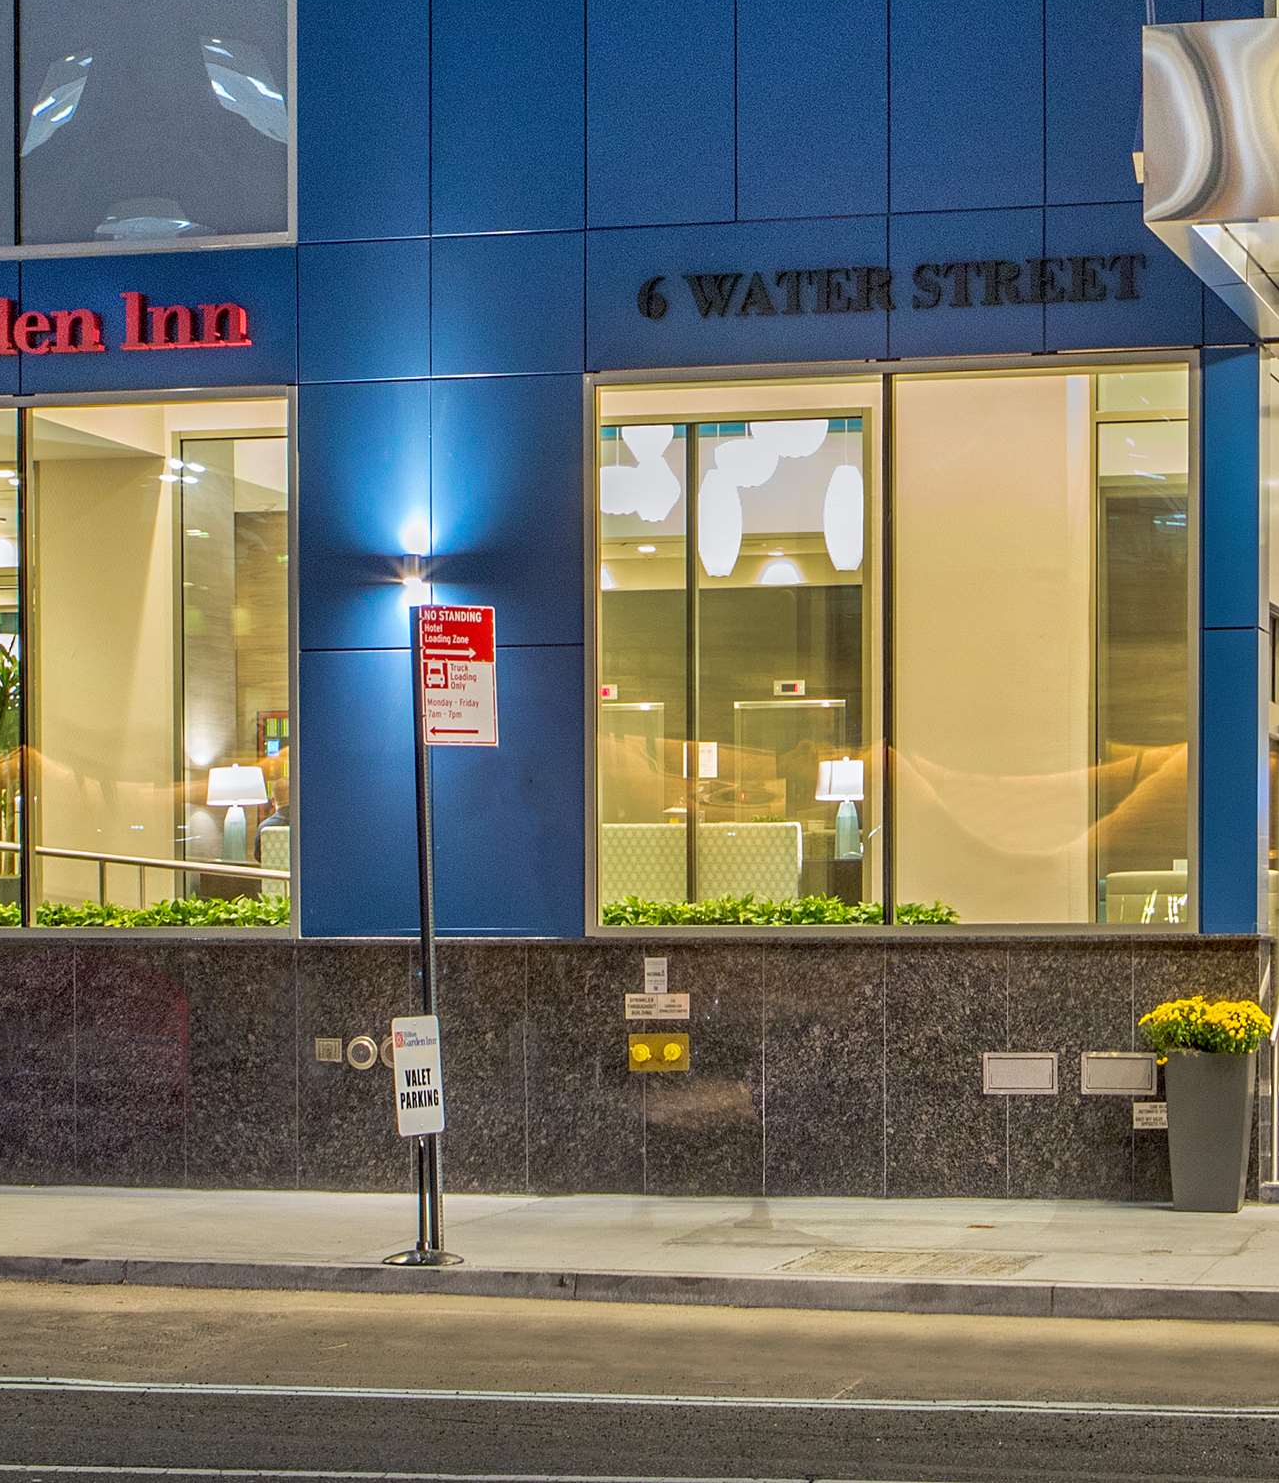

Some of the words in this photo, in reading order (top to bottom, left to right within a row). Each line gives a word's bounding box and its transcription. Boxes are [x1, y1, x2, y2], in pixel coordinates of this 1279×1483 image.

[636, 274, 669, 321] 6
[682, 266, 896, 319] WATER
[912, 253, 1147, 310] STREET
[120, 291, 252, 351] Inn
[423, 610, 437, 621] NO
[439, 610, 482, 623] STANDING
[424, 623, 443, 633] Hotel
[424, 634, 451, 645] Loading
[452, 635, 470, 645] Zone
[450, 663, 469, 672] Truck
[450, 673, 478, 683] Loading
[450, 682, 467, 691] Only
[427, 698, 453, 708] Monday
[459, 698, 480, 709] Friday
[404, 1036, 425, 1047] Garden
[405, 1068, 432, 1088] VALET
[400, 1089, 440, 1110] PARKING
